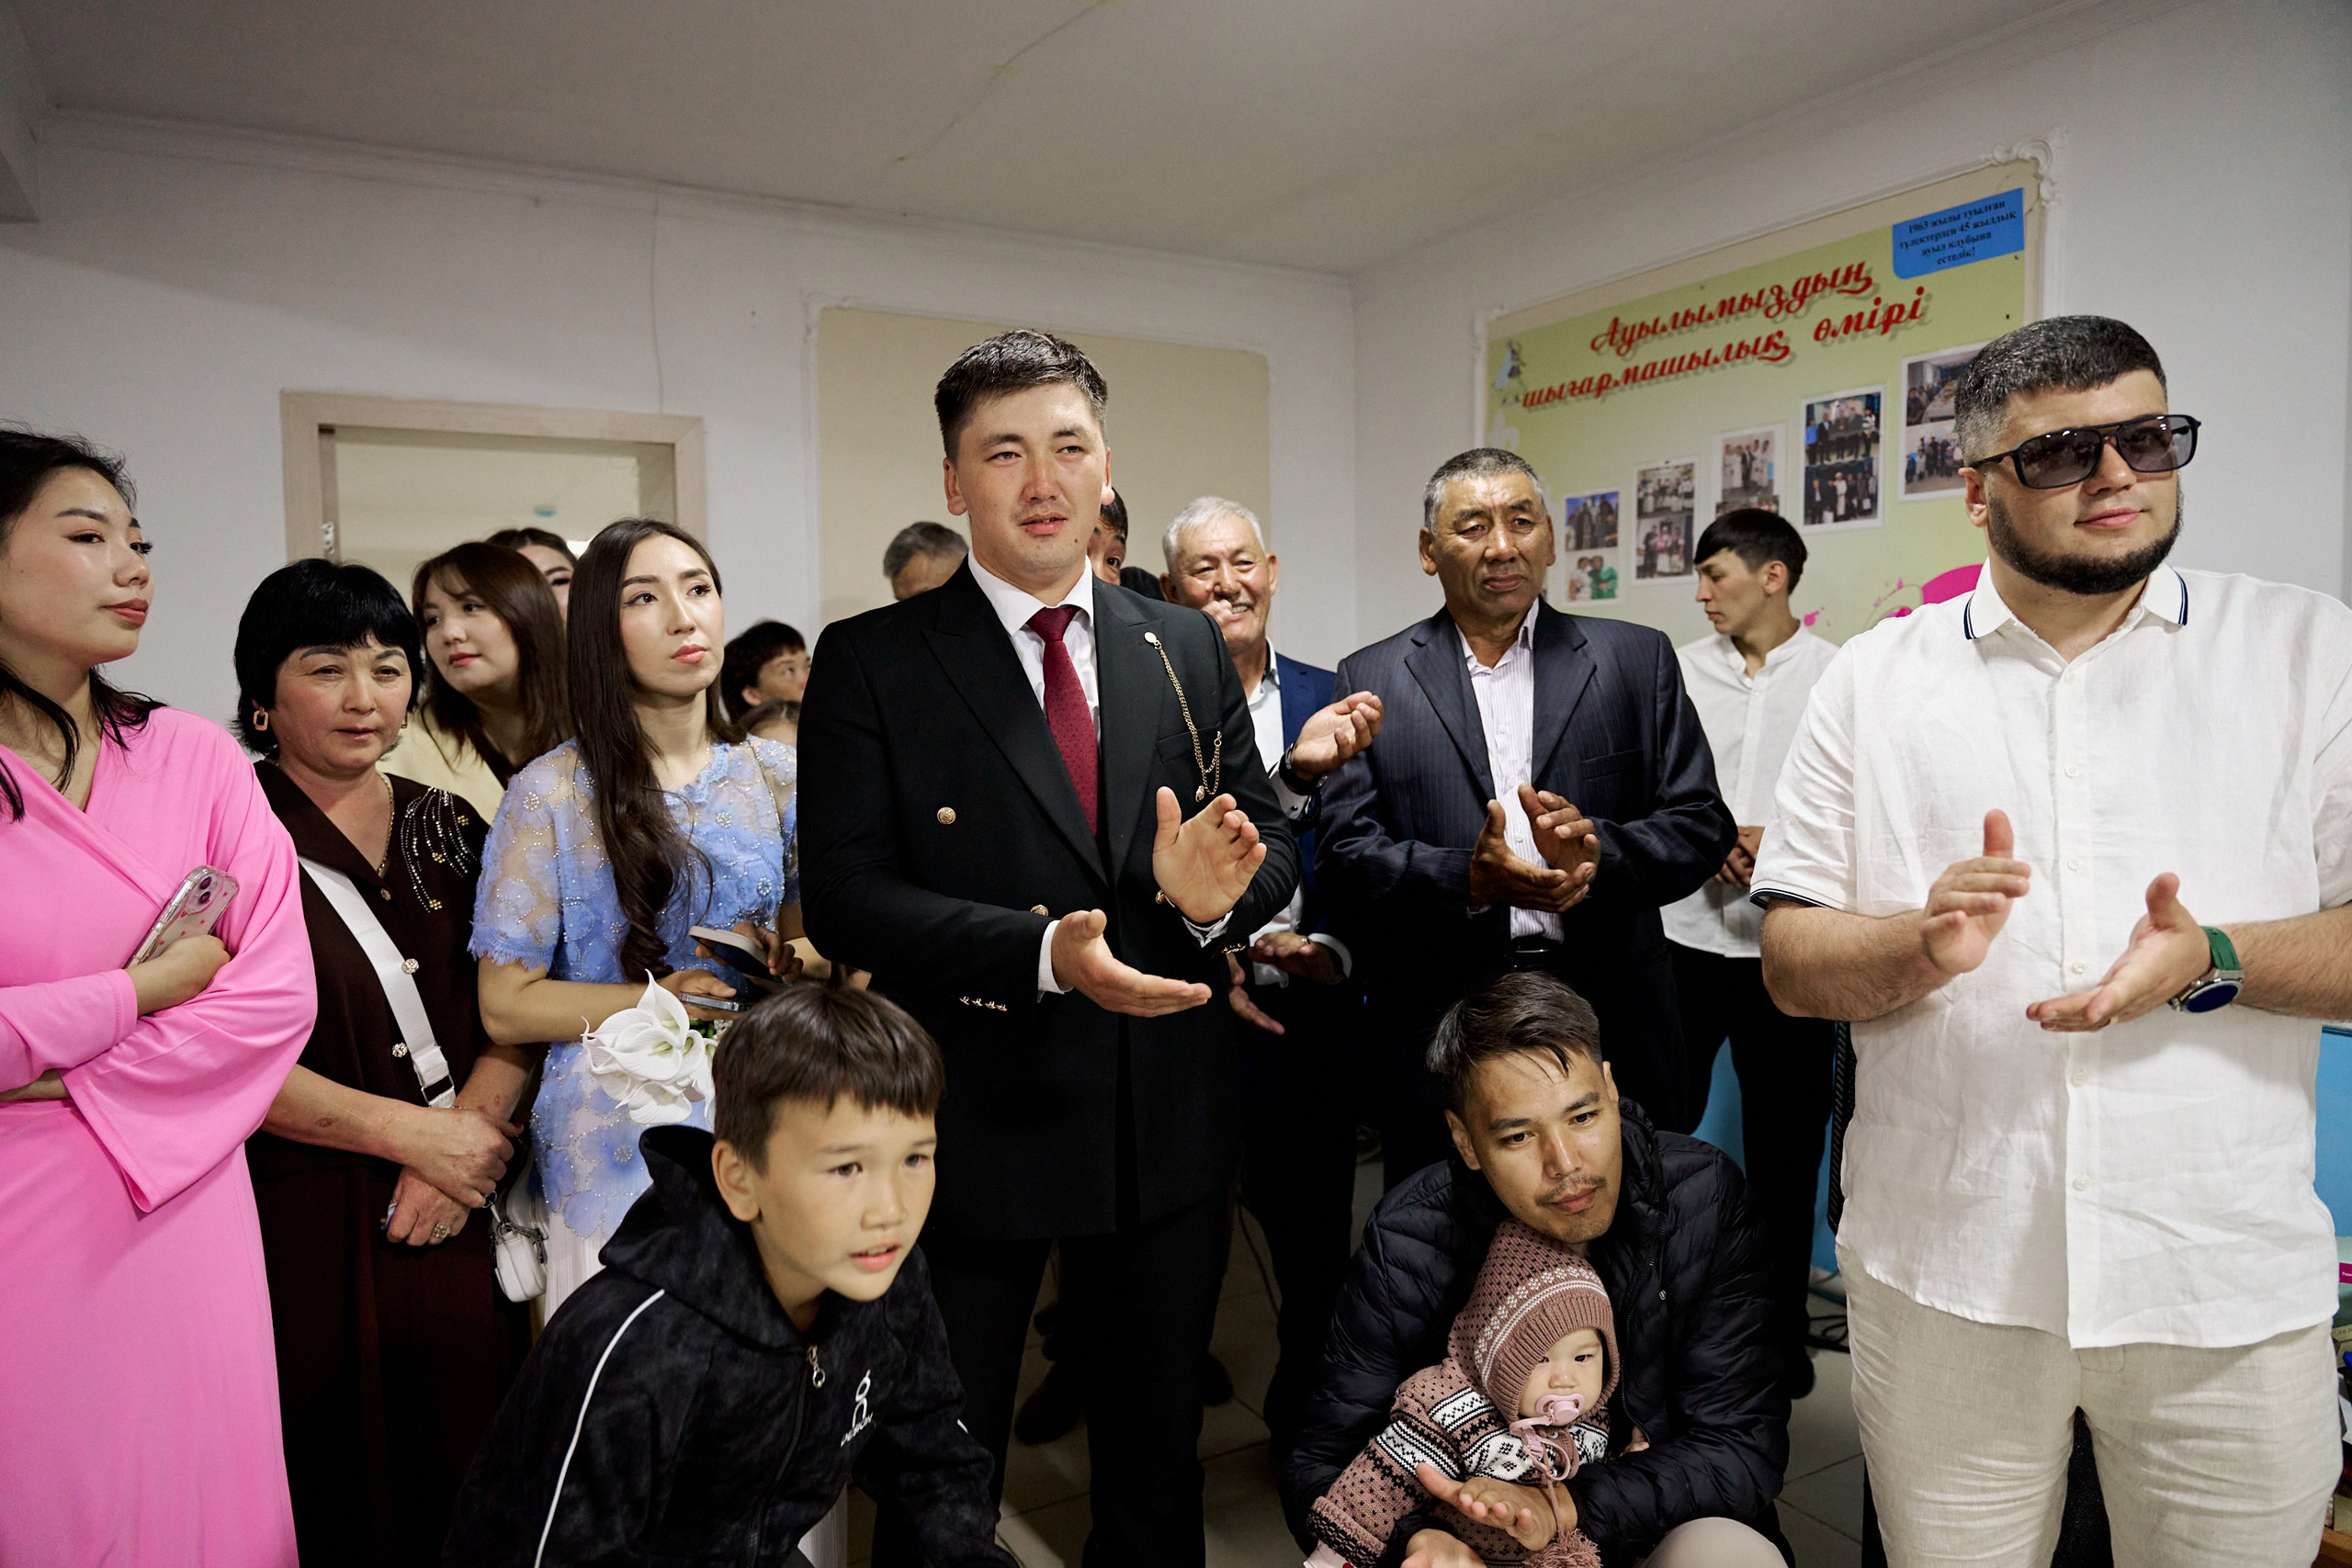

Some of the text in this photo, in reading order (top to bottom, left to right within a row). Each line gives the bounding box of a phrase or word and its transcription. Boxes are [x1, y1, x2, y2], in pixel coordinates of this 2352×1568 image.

[1931, 213, 1961, 227] жылы
[1960, 221, 1971, 232] 45
[1590, 261, 1873, 356] Ауылымыздың
[1521, 286, 1926, 409] шығармашылық өмірі
